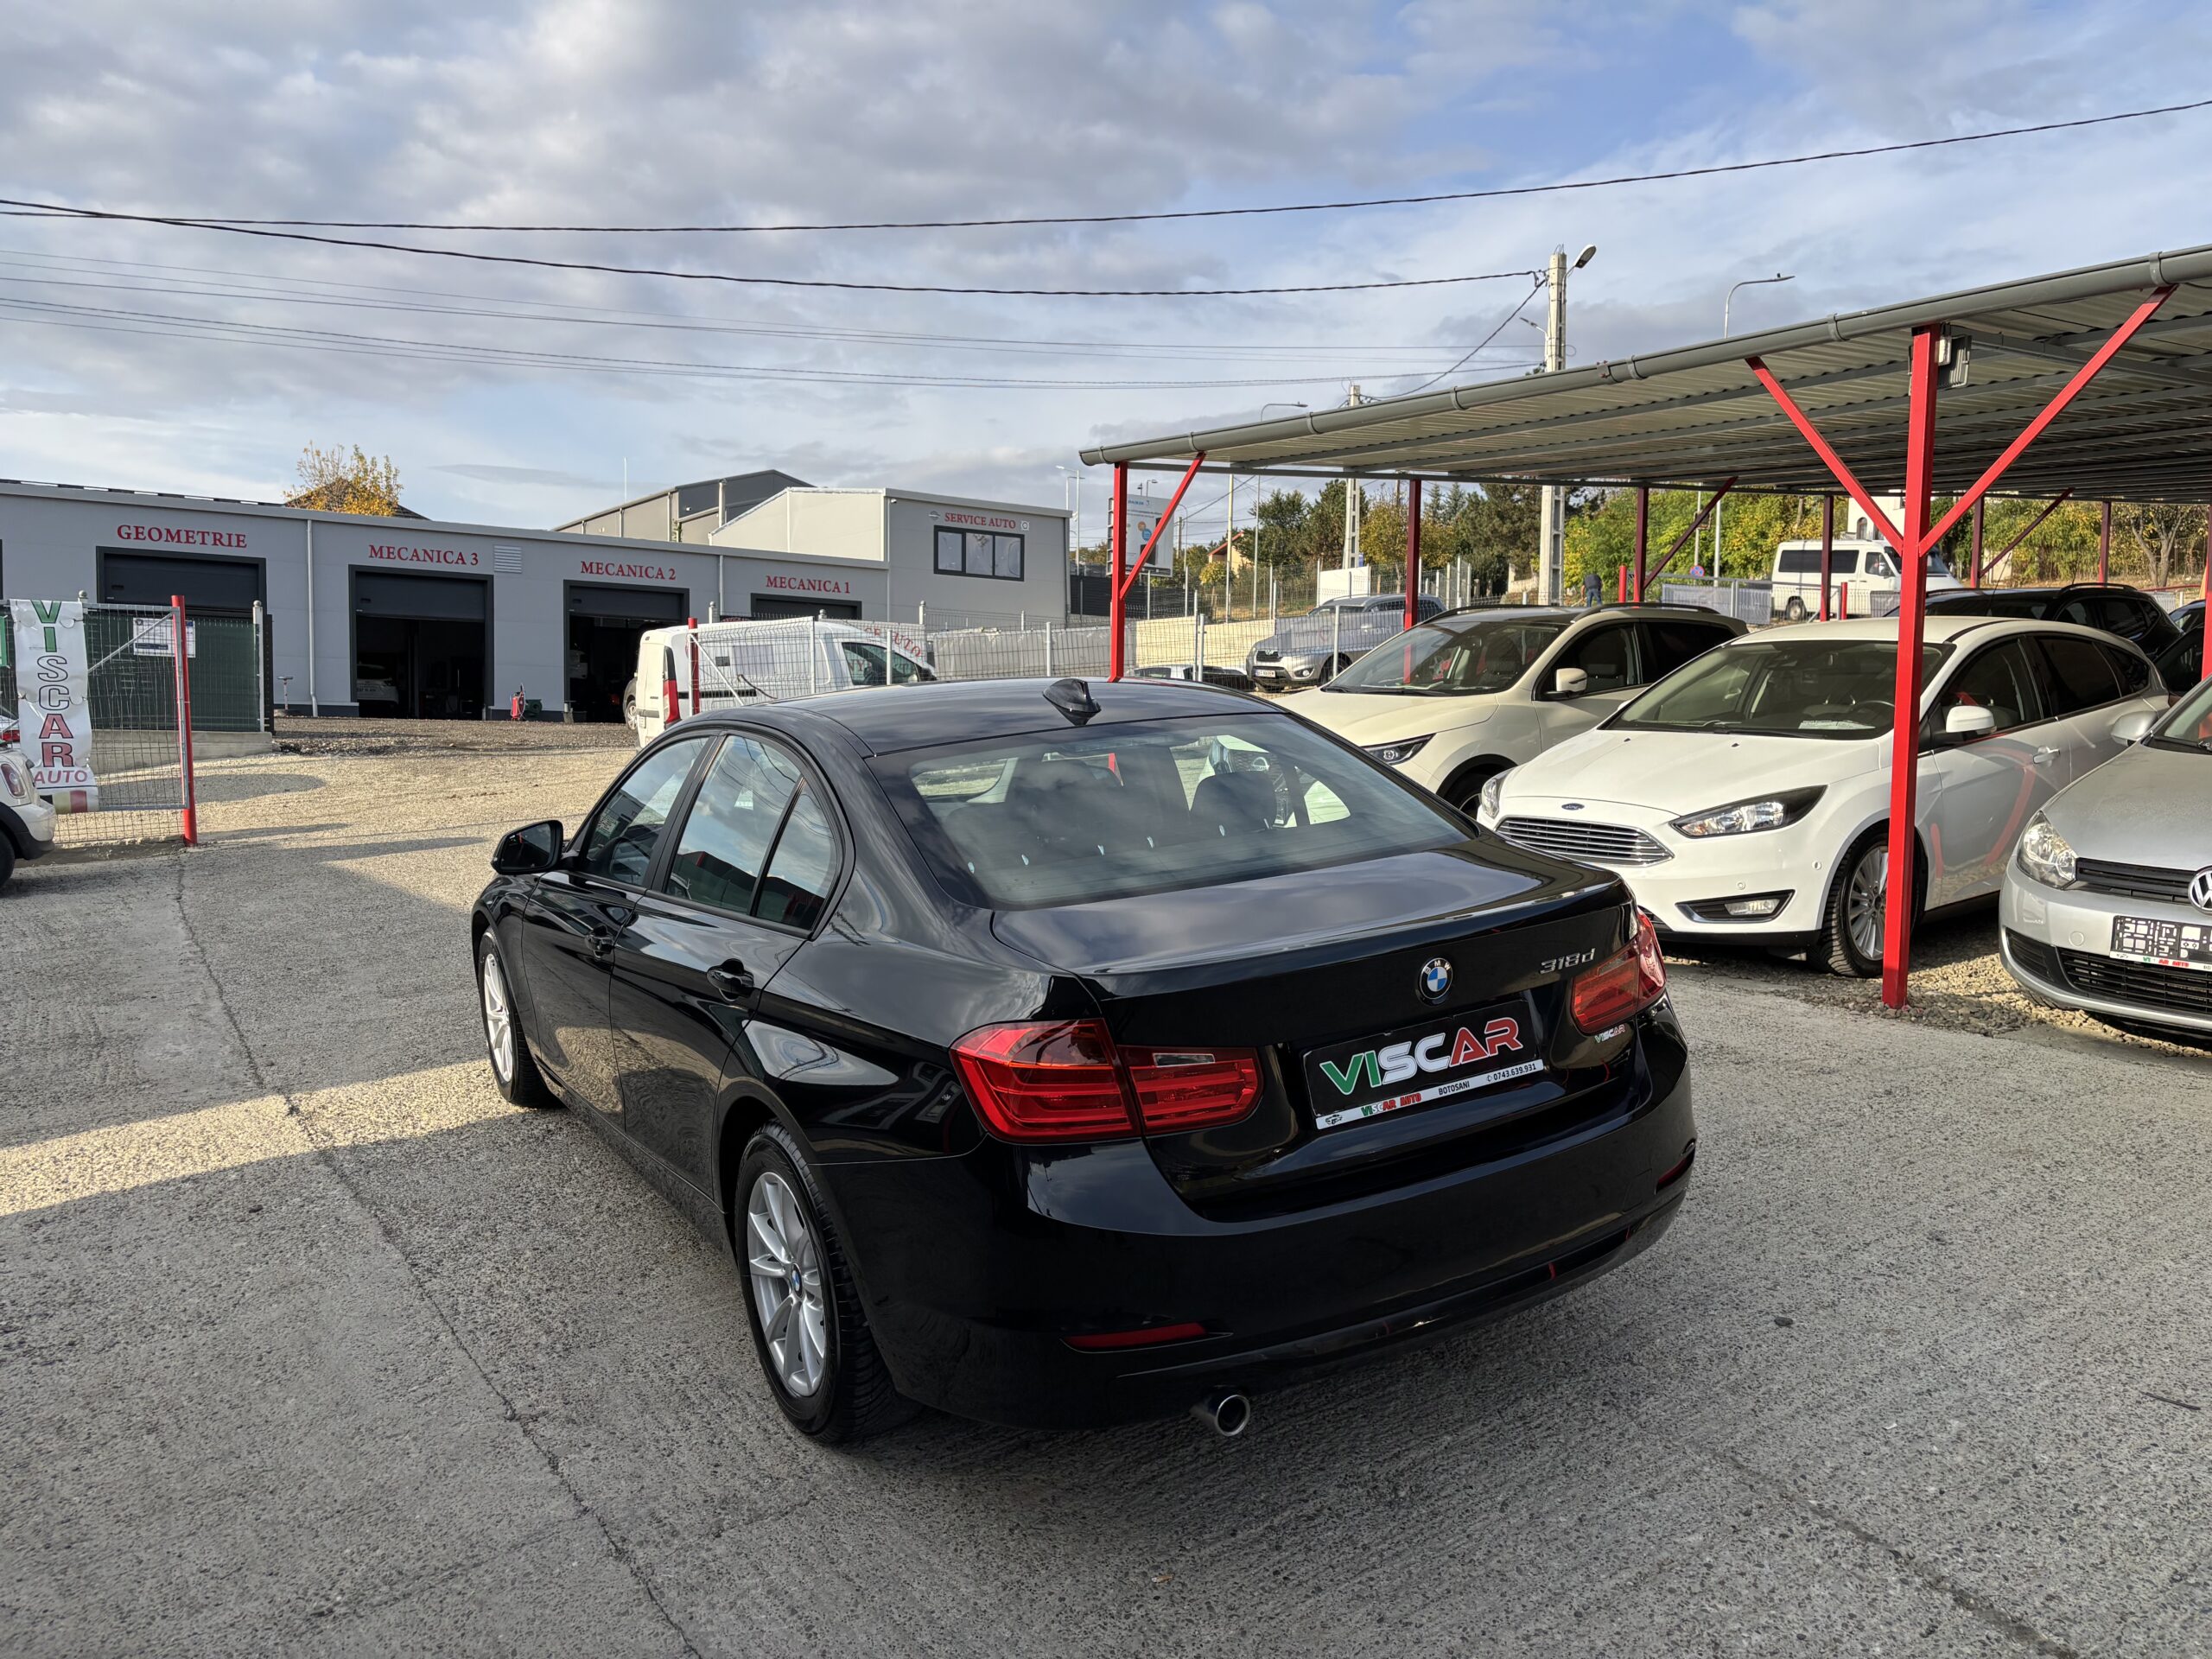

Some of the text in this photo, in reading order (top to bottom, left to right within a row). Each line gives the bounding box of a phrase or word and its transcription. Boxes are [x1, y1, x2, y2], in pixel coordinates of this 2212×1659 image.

[944, 512, 1016, 529] SERVICE AUTO
[117, 524, 247, 549] GEOMETRIE
[368, 544, 479, 566] MECANICA 3
[580, 560, 677, 581] MECANICA 2
[766, 575, 851, 594] MECANICA 1
[893, 631, 922, 658] UTO
[30, 600, 75, 768] VISCAR
[34, 769, 88, 785] AUTO
[1424, 959, 1452, 975] BMW
[1540, 948, 1596, 975] 318d
[1594, 1024, 1625, 1044] VISCAR
[1319, 1017, 1523, 1096] VISCAR
[1361, 1063, 1537, 1116] VISCAR AUTO BOTOSANI 0743.639.931
